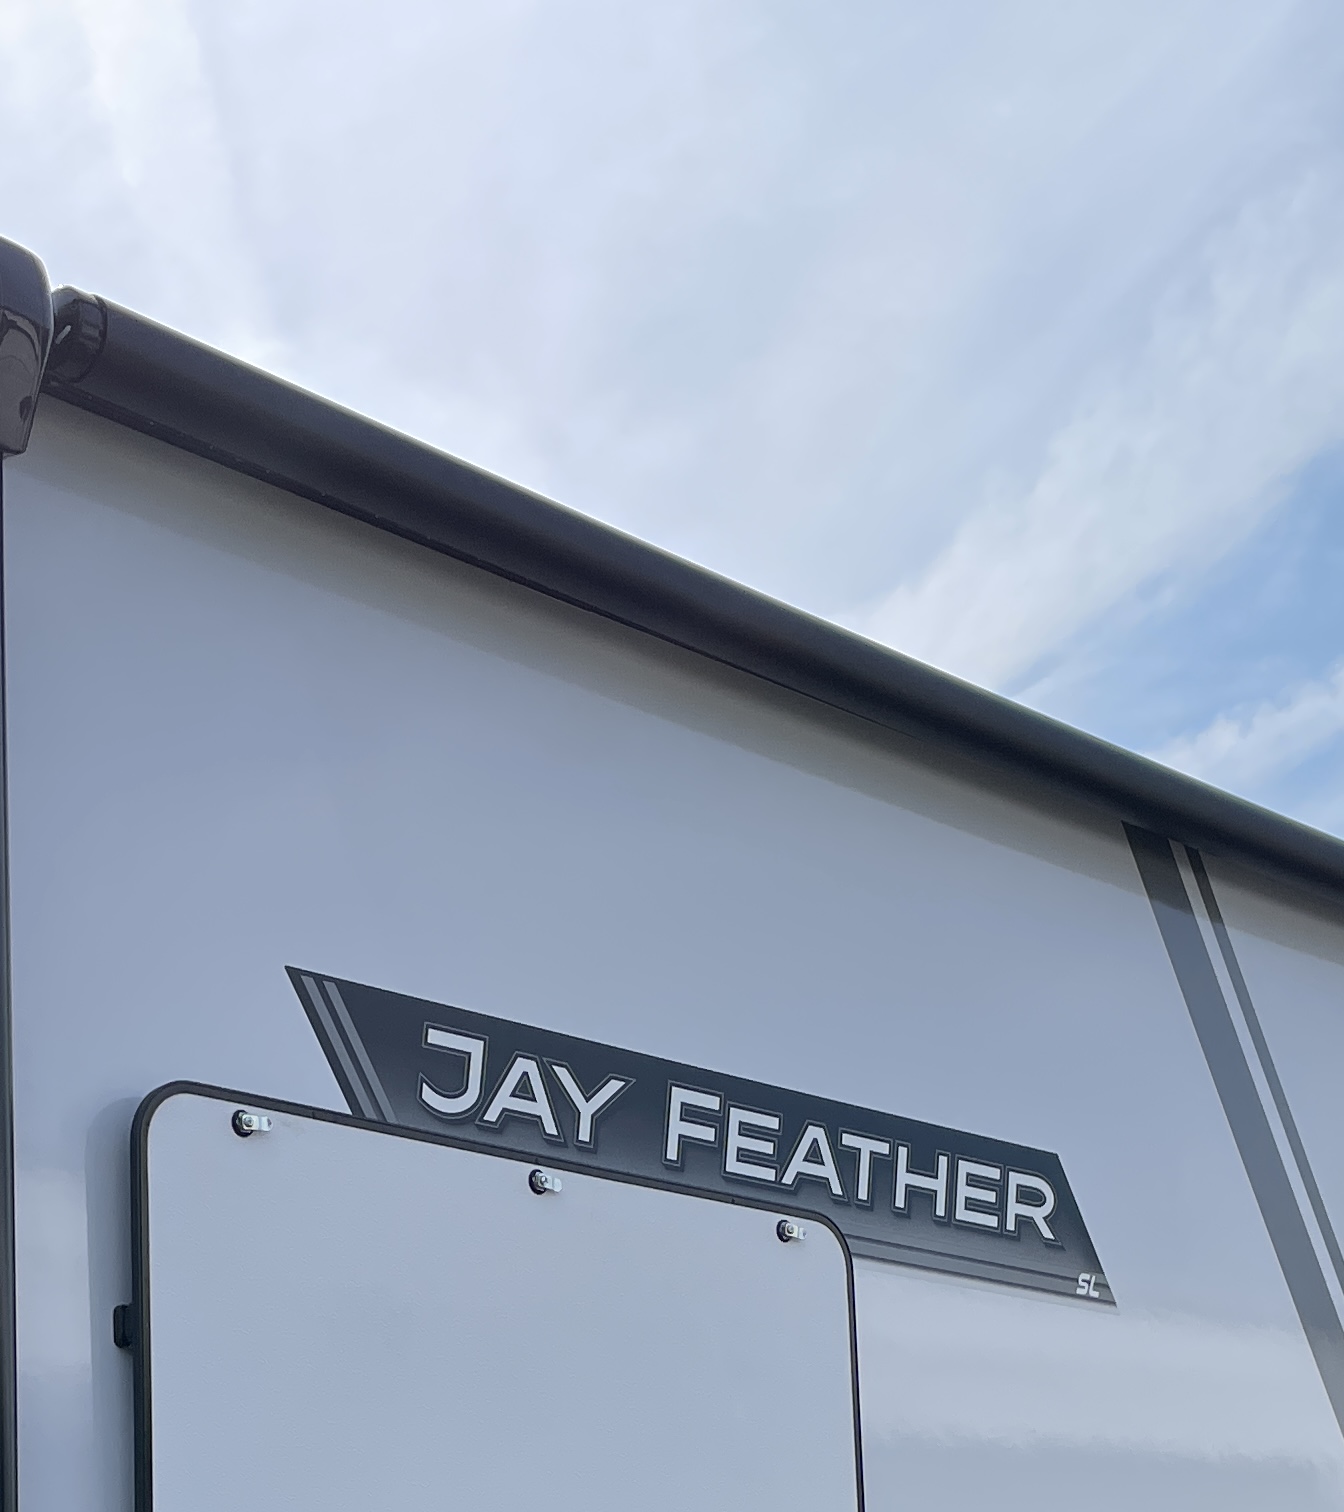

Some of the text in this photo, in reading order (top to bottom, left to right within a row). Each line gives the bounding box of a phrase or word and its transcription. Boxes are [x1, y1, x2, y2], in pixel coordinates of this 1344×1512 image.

[418, 1024, 1060, 1243] JAY FEATHER
[1076, 1272, 1100, 1299] SL
